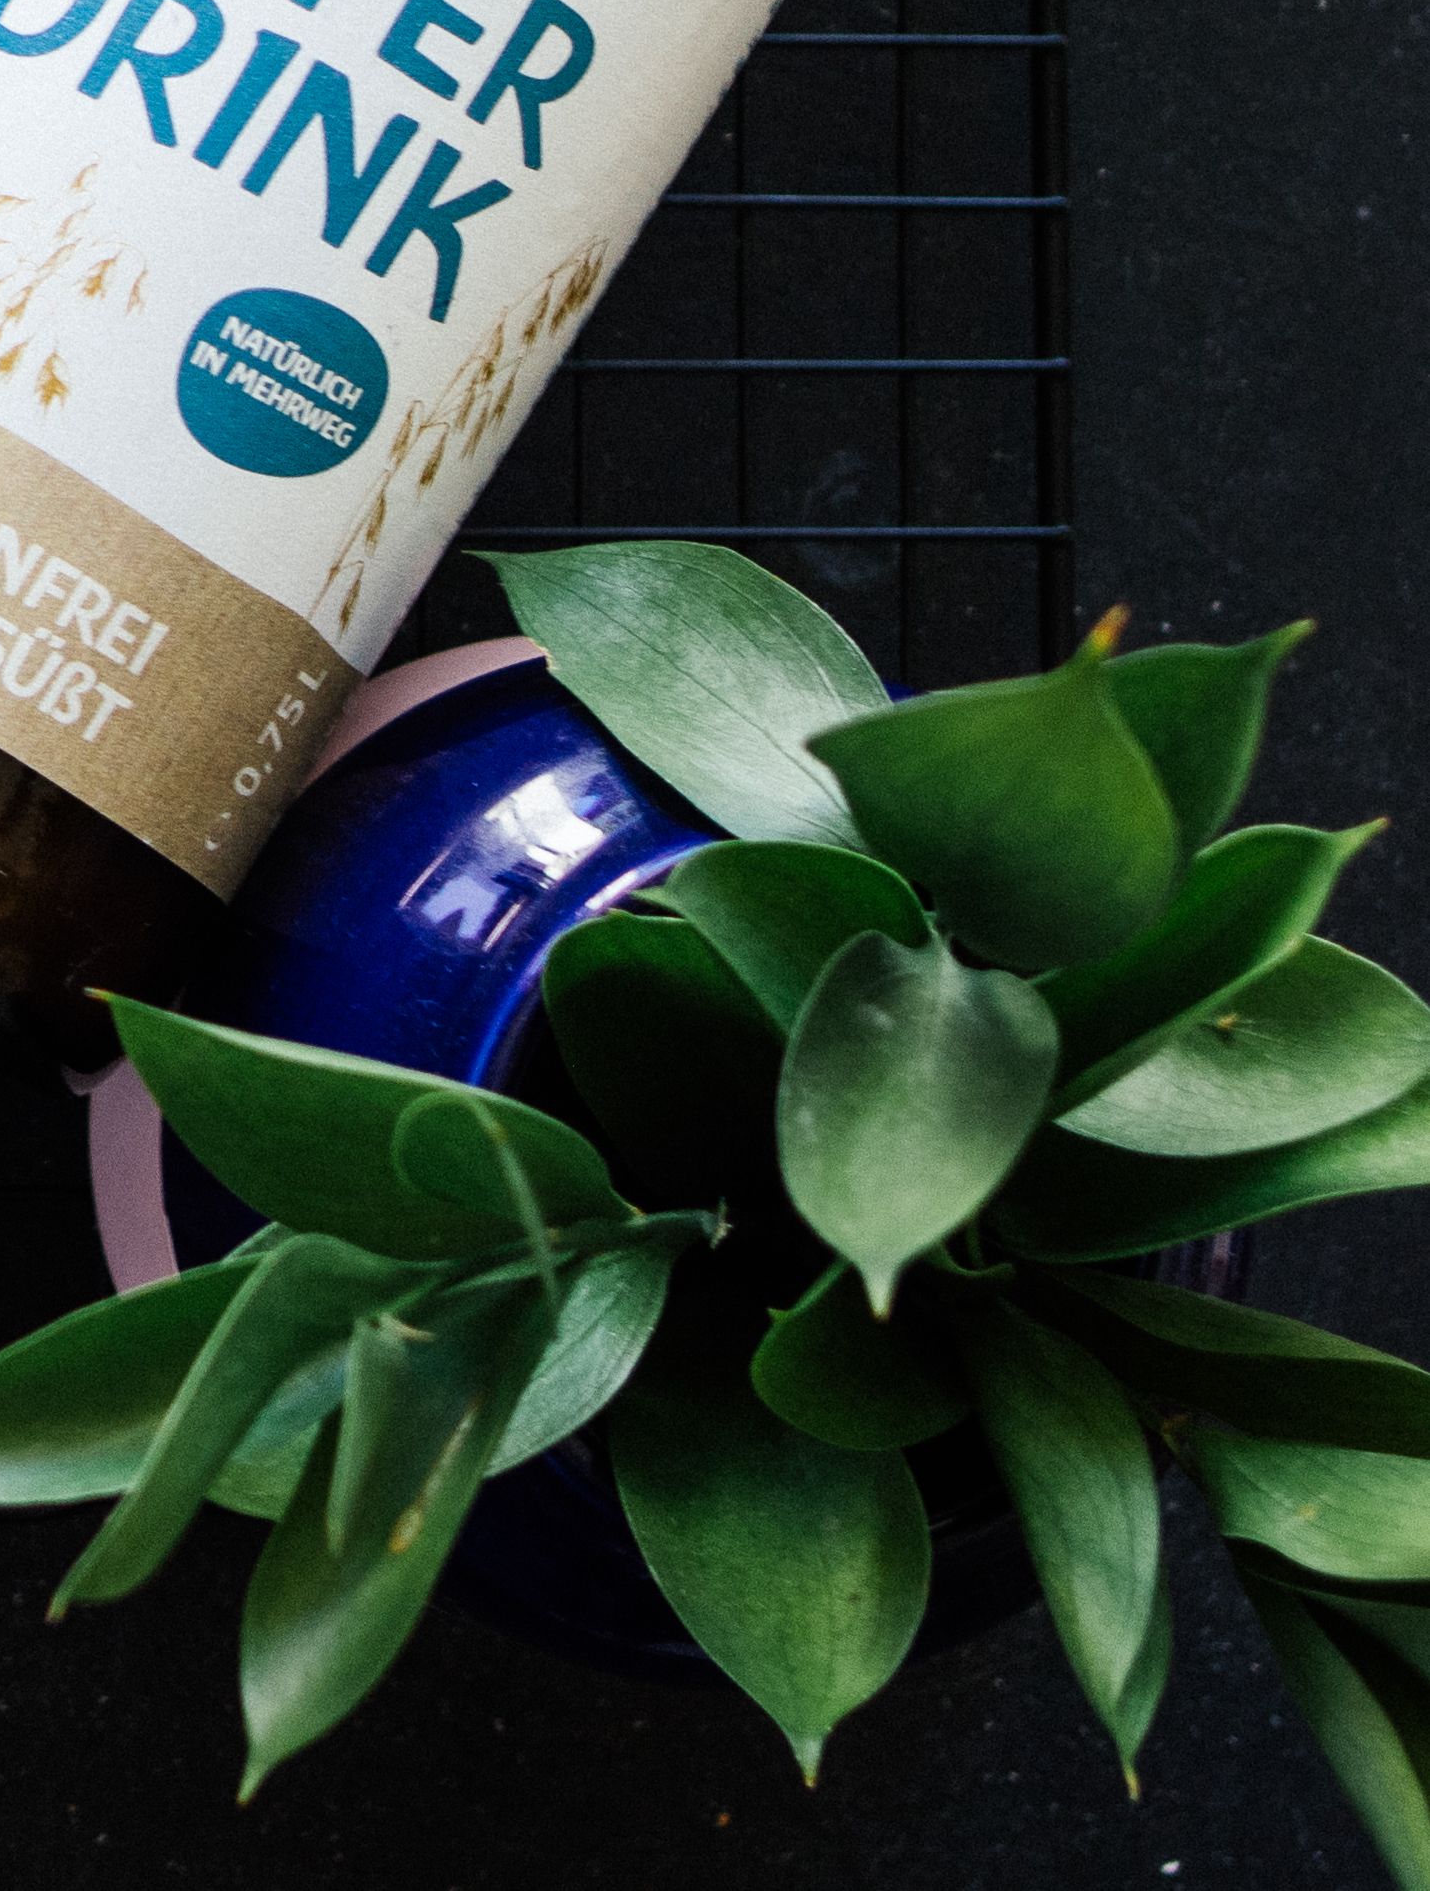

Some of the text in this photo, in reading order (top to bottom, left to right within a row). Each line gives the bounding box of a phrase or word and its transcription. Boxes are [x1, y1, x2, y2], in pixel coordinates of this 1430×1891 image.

[189, 340, 357, 449] IN MEHRWEG
[219, 315, 364, 410] NATÜRLICH
